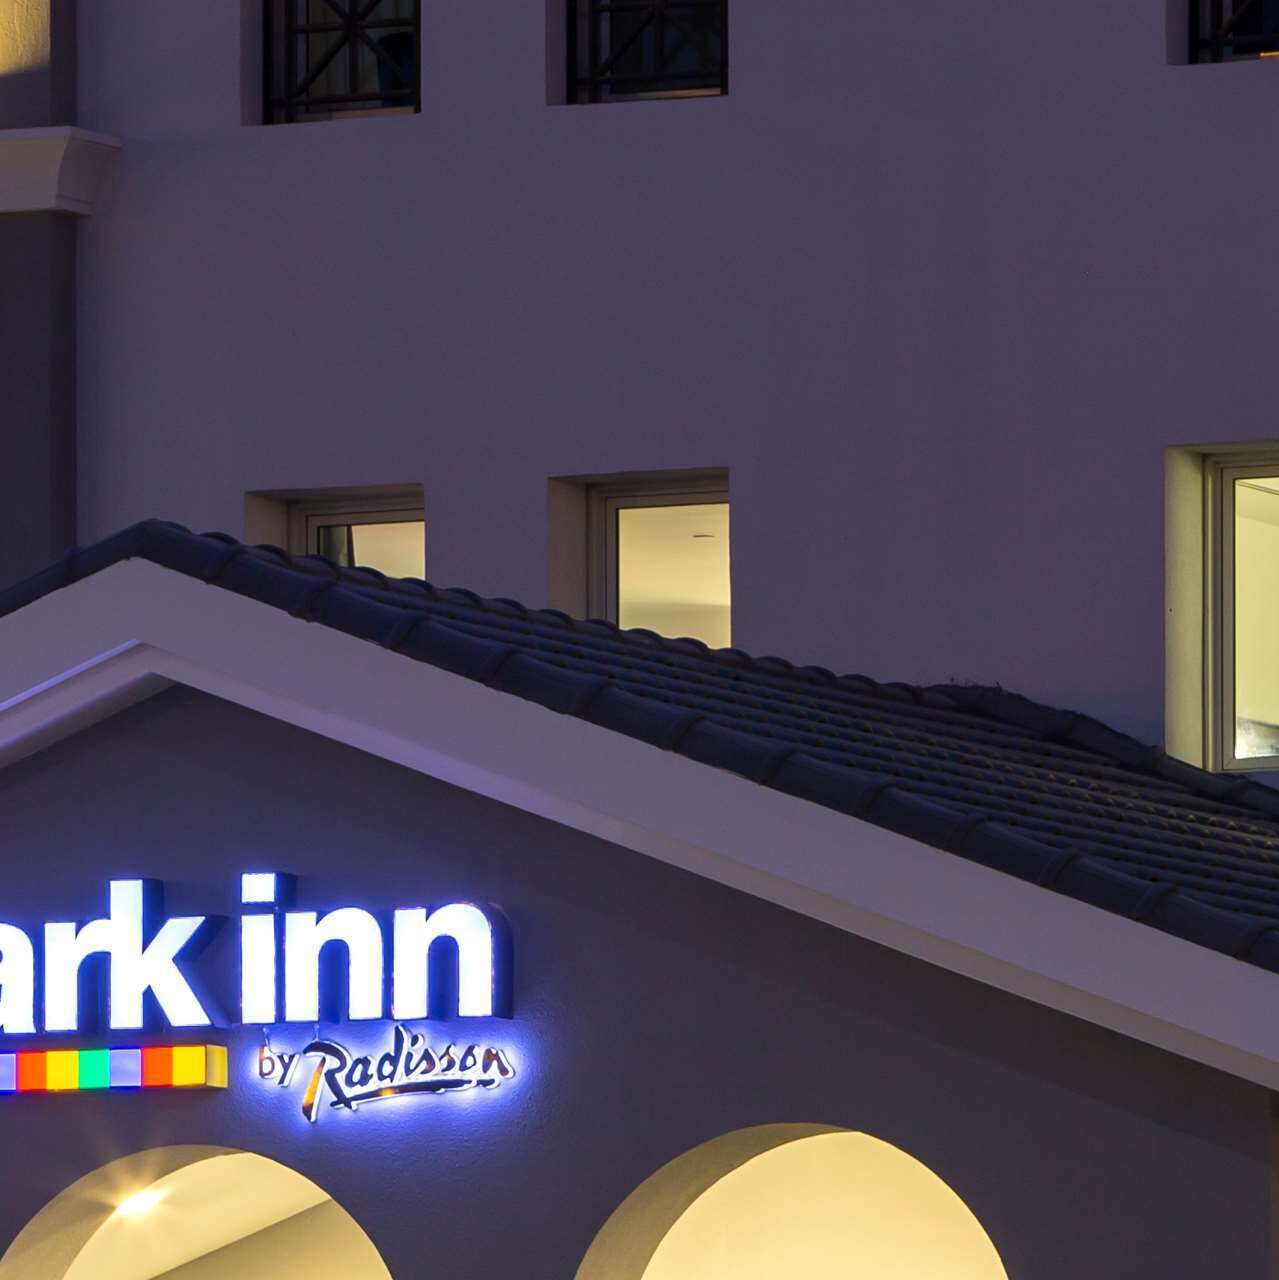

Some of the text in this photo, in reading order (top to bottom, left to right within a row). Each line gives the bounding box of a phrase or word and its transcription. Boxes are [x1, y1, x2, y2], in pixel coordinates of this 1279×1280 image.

[240, 872, 496, 1025] inn
[258, 1024, 515, 1123] by Radisson
